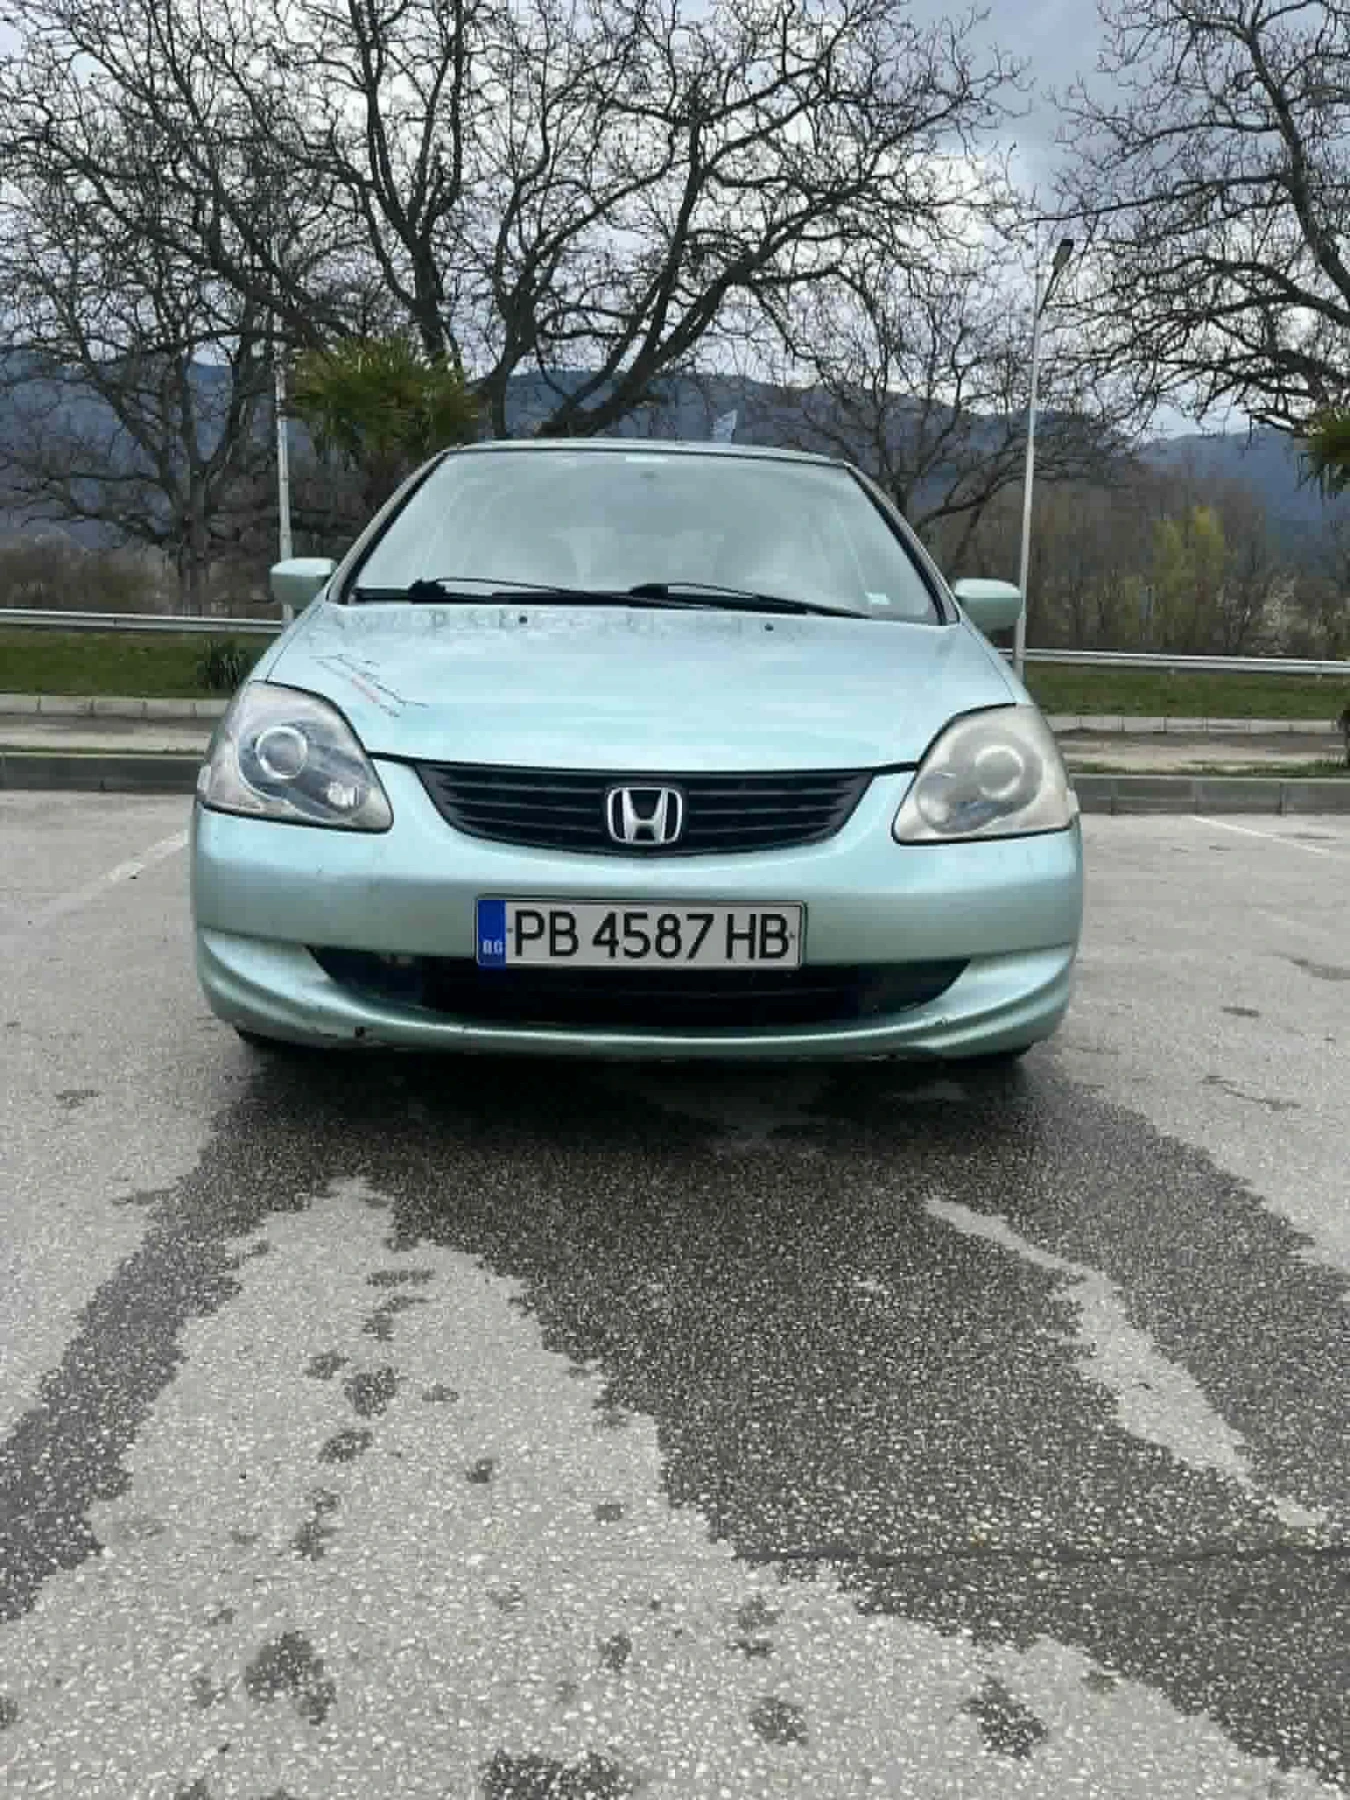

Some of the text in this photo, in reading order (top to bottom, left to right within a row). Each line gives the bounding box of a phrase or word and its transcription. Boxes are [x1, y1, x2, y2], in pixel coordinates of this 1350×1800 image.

[514, 909, 790, 960] PB 4587 HB
